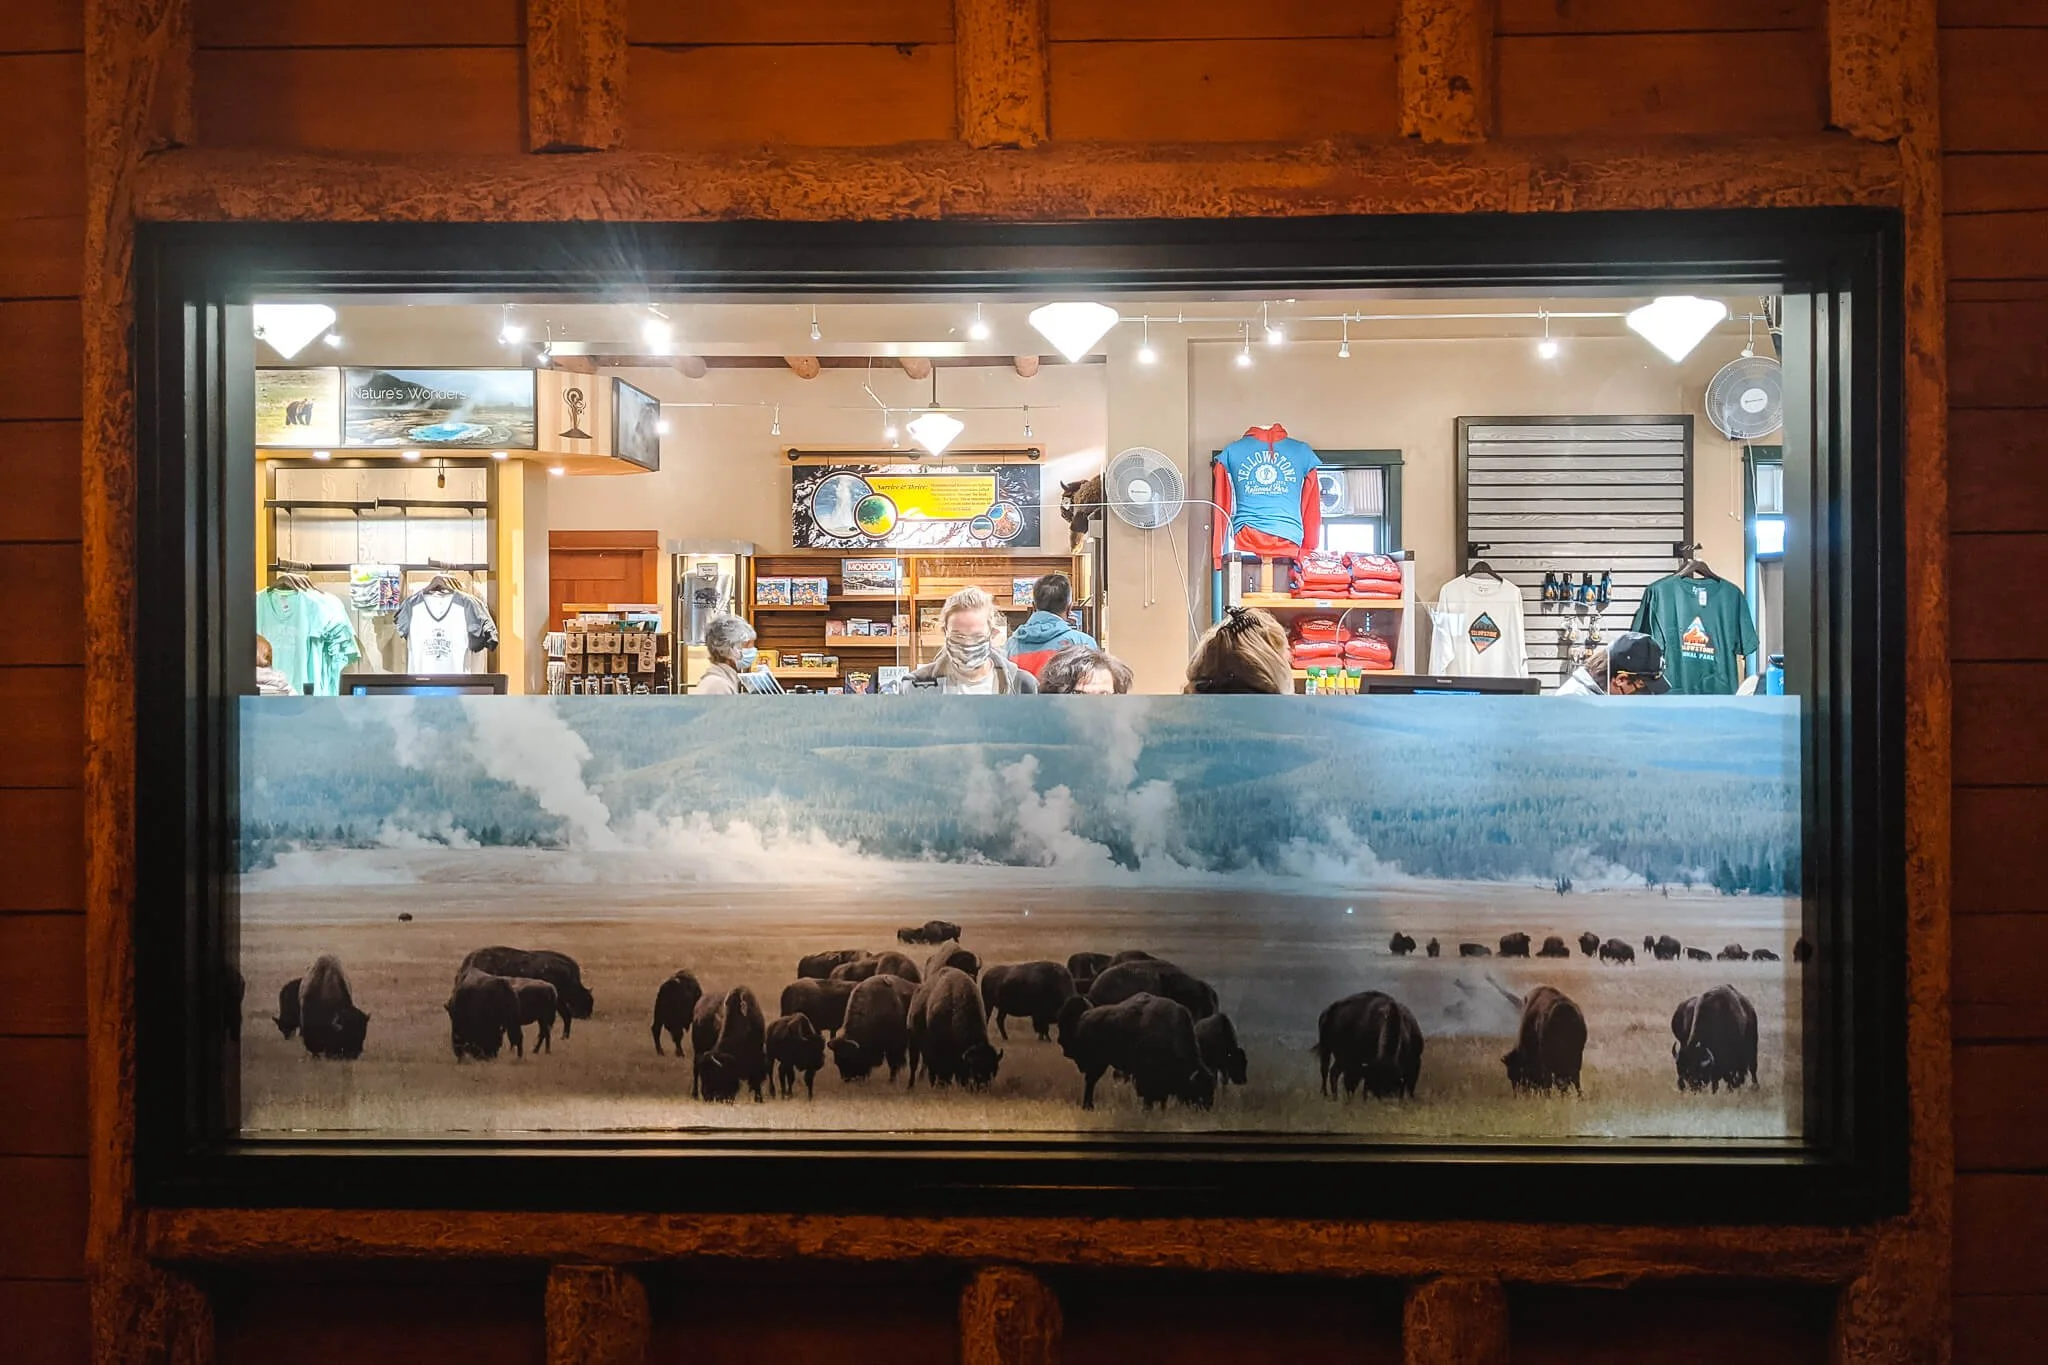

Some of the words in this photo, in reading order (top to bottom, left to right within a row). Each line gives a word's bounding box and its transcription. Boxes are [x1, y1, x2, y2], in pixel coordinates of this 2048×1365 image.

[351, 387, 404, 400] Nature's
[407, 387, 466, 400] Wonders
[1238, 450, 1297, 482] YELLOWSTONE
[847, 562, 891, 571] MONOPOLY
